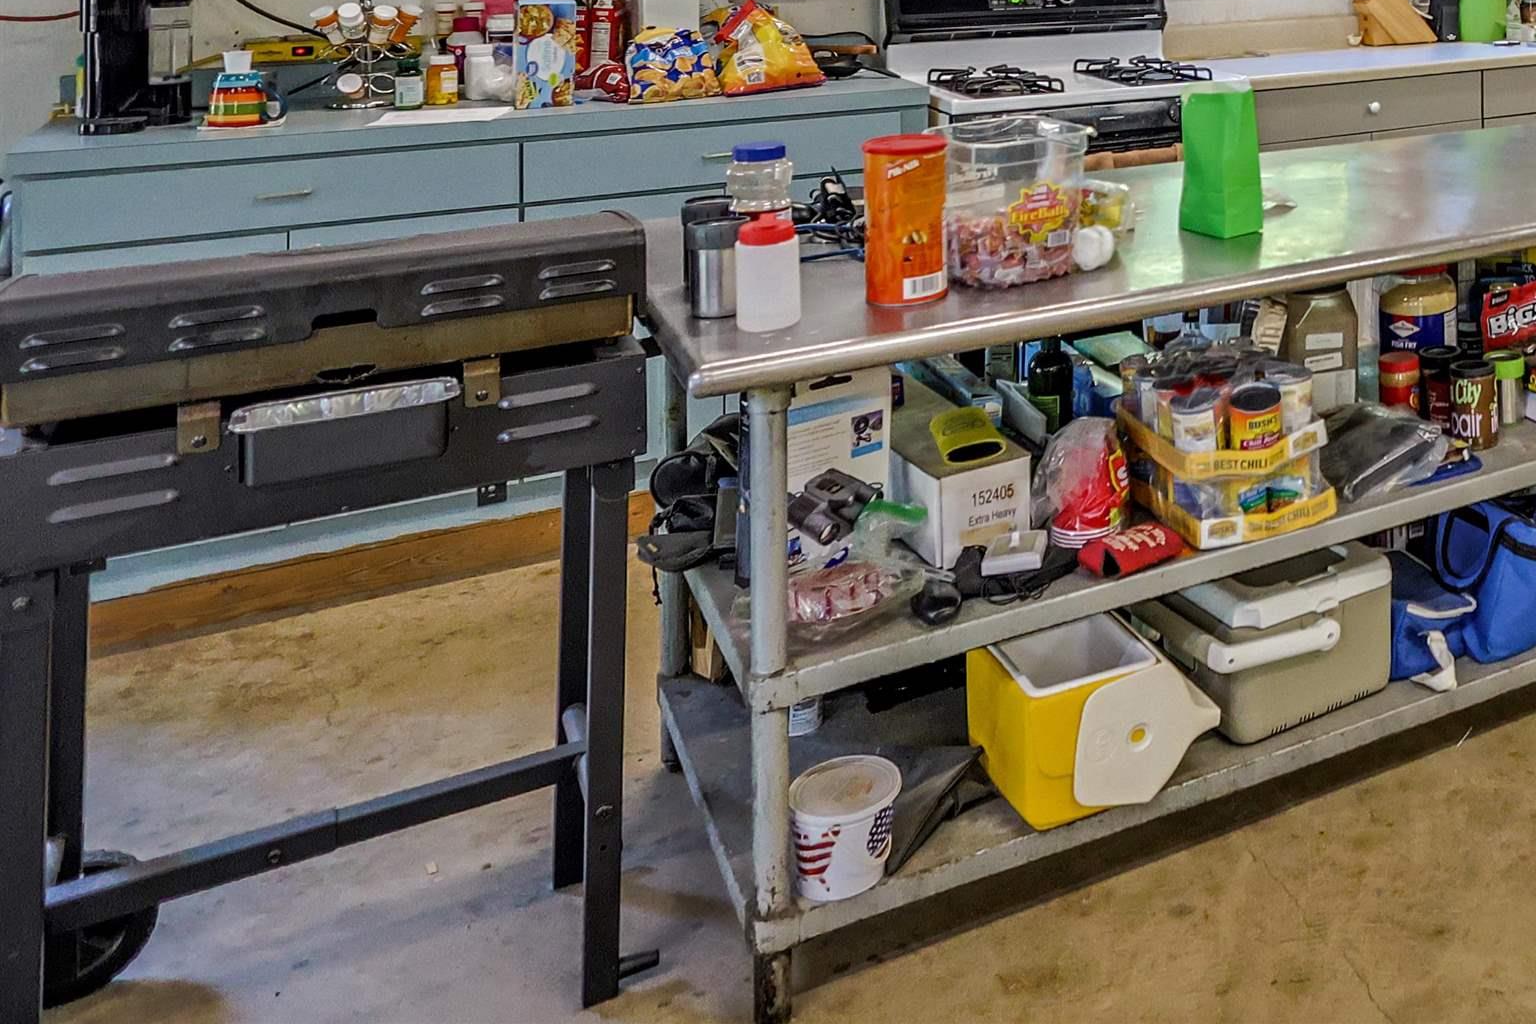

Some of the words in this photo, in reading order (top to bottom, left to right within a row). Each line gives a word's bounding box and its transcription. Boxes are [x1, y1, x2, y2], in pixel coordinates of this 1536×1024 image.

[1455, 378, 1483, 410] City
[1213, 460, 1239, 471] BEST
[1240, 458, 1269, 471] CHILI
[971, 484, 1015, 508] 152405
[968, 513, 990, 528] Extra
[991, 507, 1017, 524] Heavy
